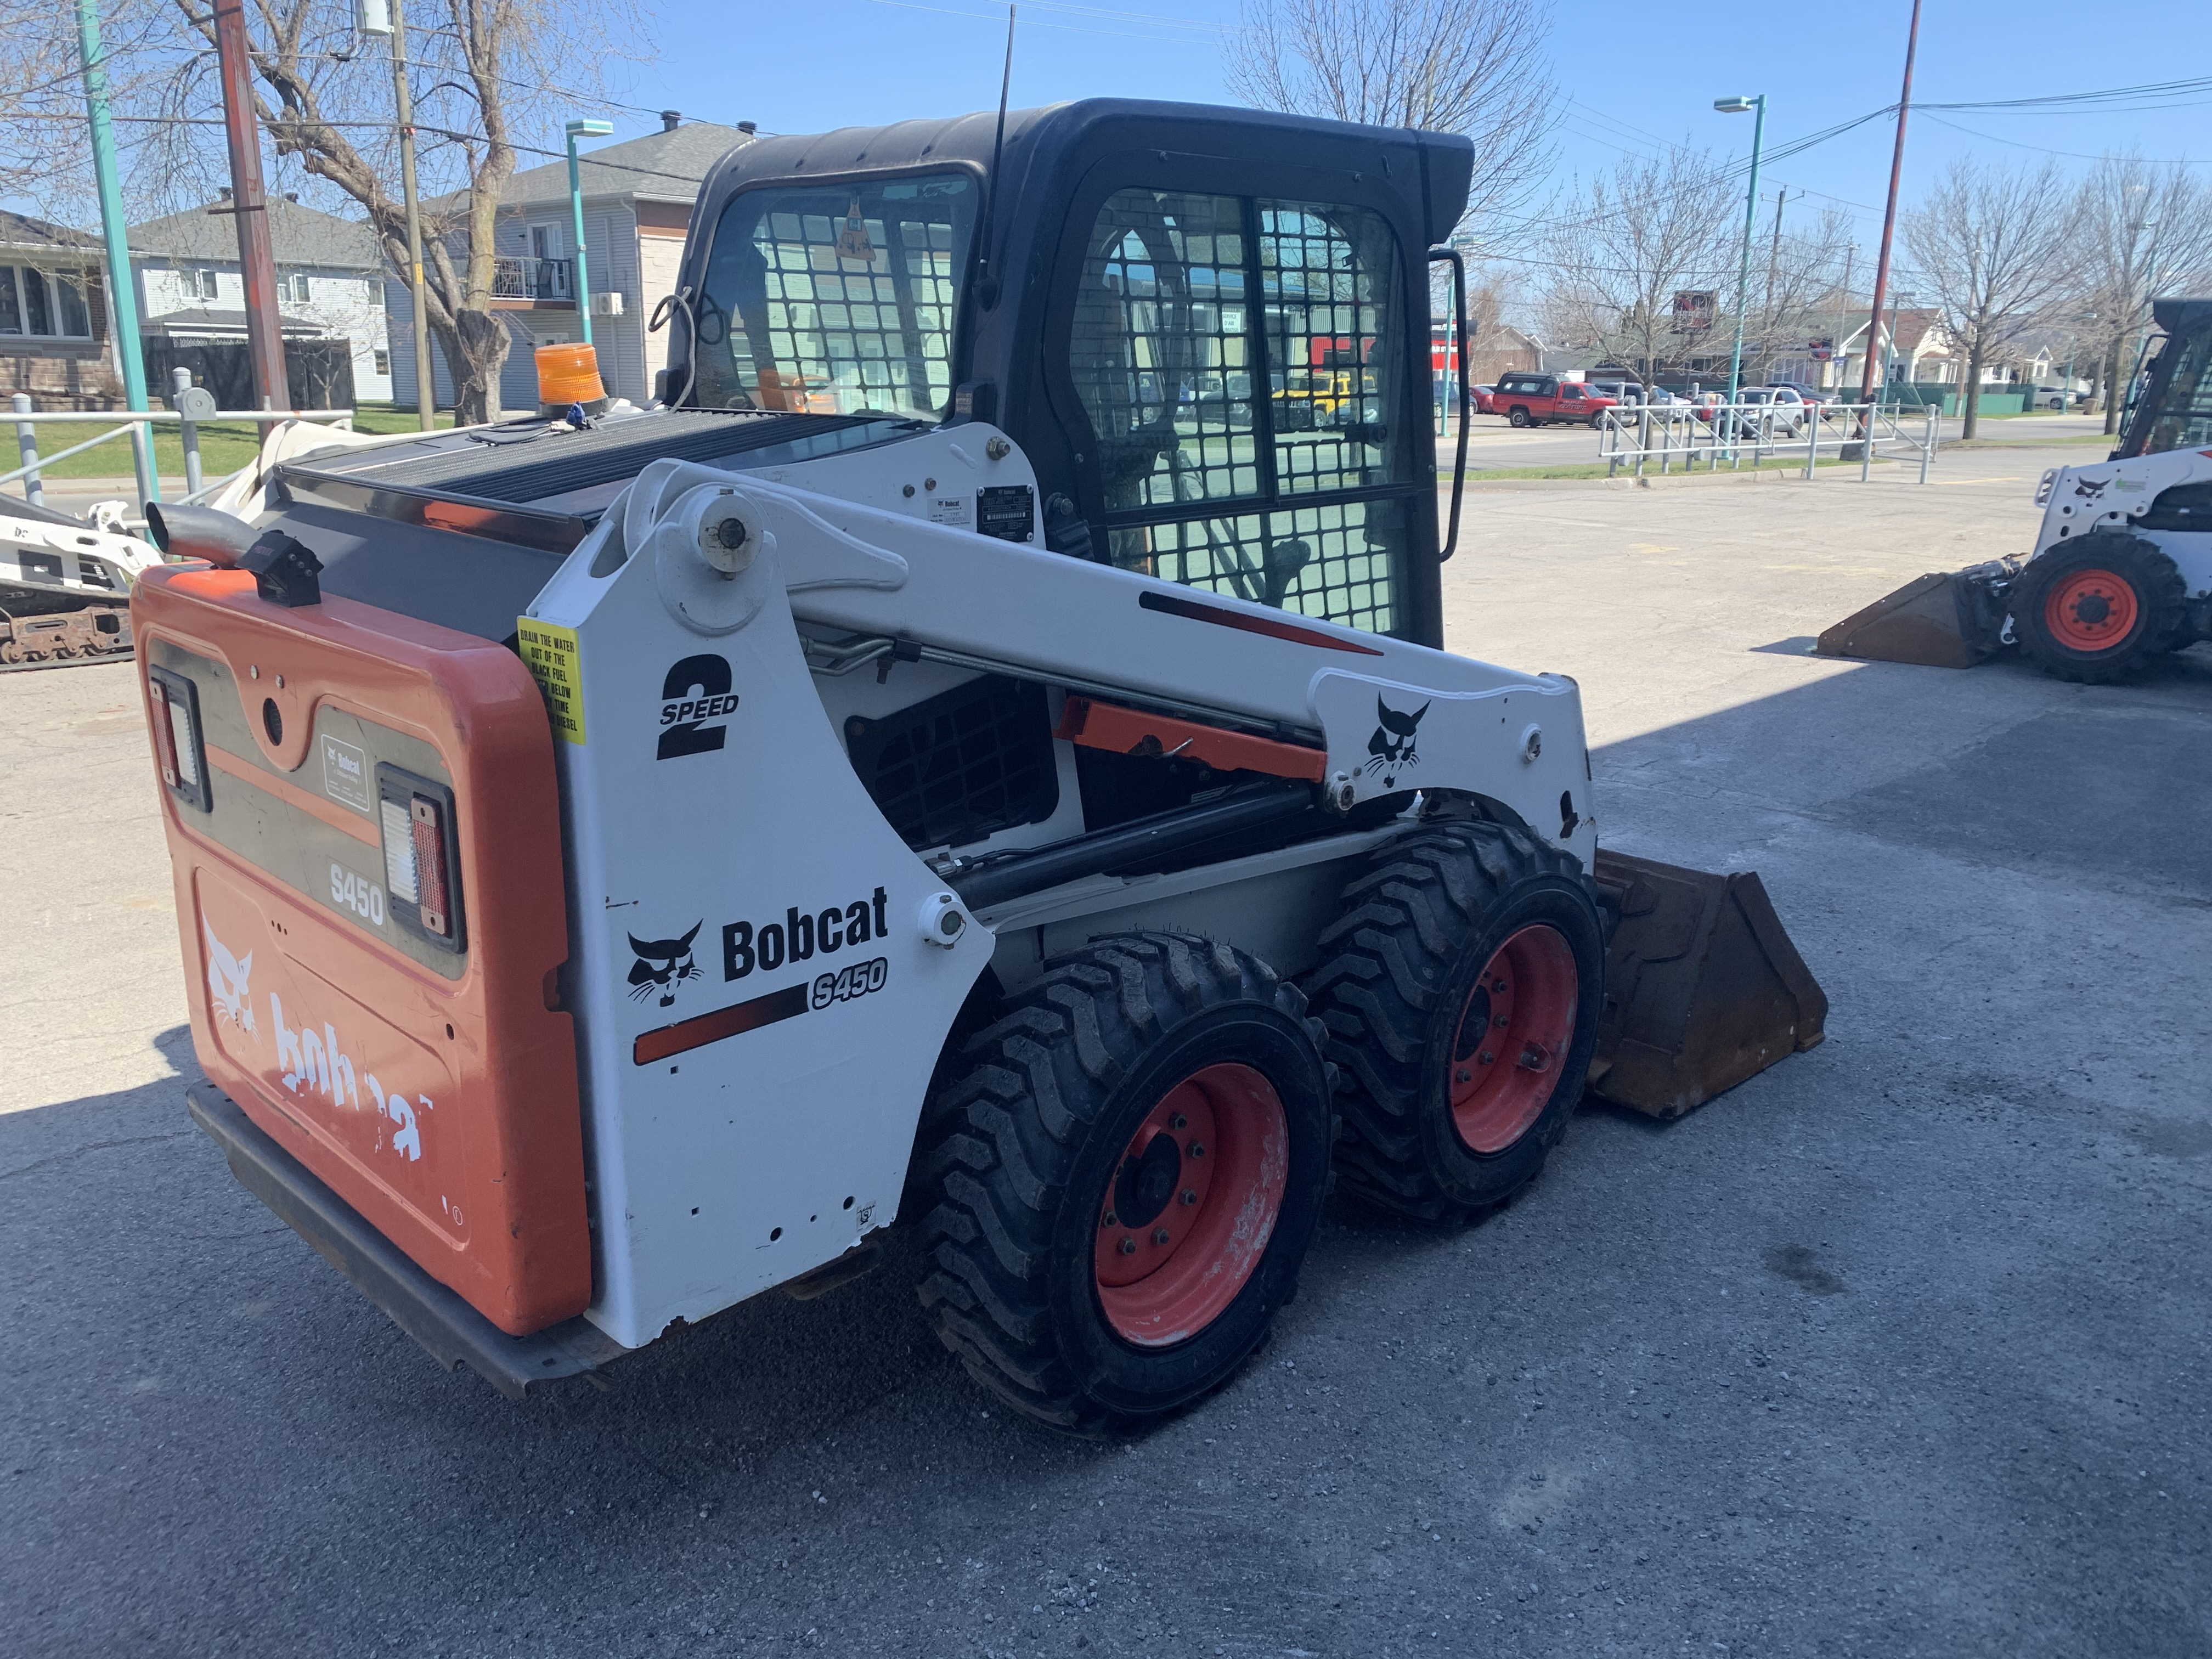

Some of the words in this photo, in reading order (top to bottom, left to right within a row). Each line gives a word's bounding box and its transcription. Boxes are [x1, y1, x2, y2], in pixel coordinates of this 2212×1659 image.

[520, 629, 538, 644] DRAIN
[540, 634, 551, 647] THE
[554, 637, 575, 653] WATER
[531, 647, 542, 659] OUT
[545, 651, 552, 663] OF
[554, 653, 566, 666] THE
[532, 662, 550, 678] BLACK
[552, 668, 567, 682] FUEL
[551, 682, 571, 699] BELOW
[555, 698, 569, 713] TIME
[660, 695, 739, 725] SPEED
[556, 715, 578, 731] DIESEL
[337, 752, 360, 776] Bobcat
[331, 863, 383, 926] S450
[722, 886, 888, 982] Bobcat
[811, 956, 889, 1009] S450
